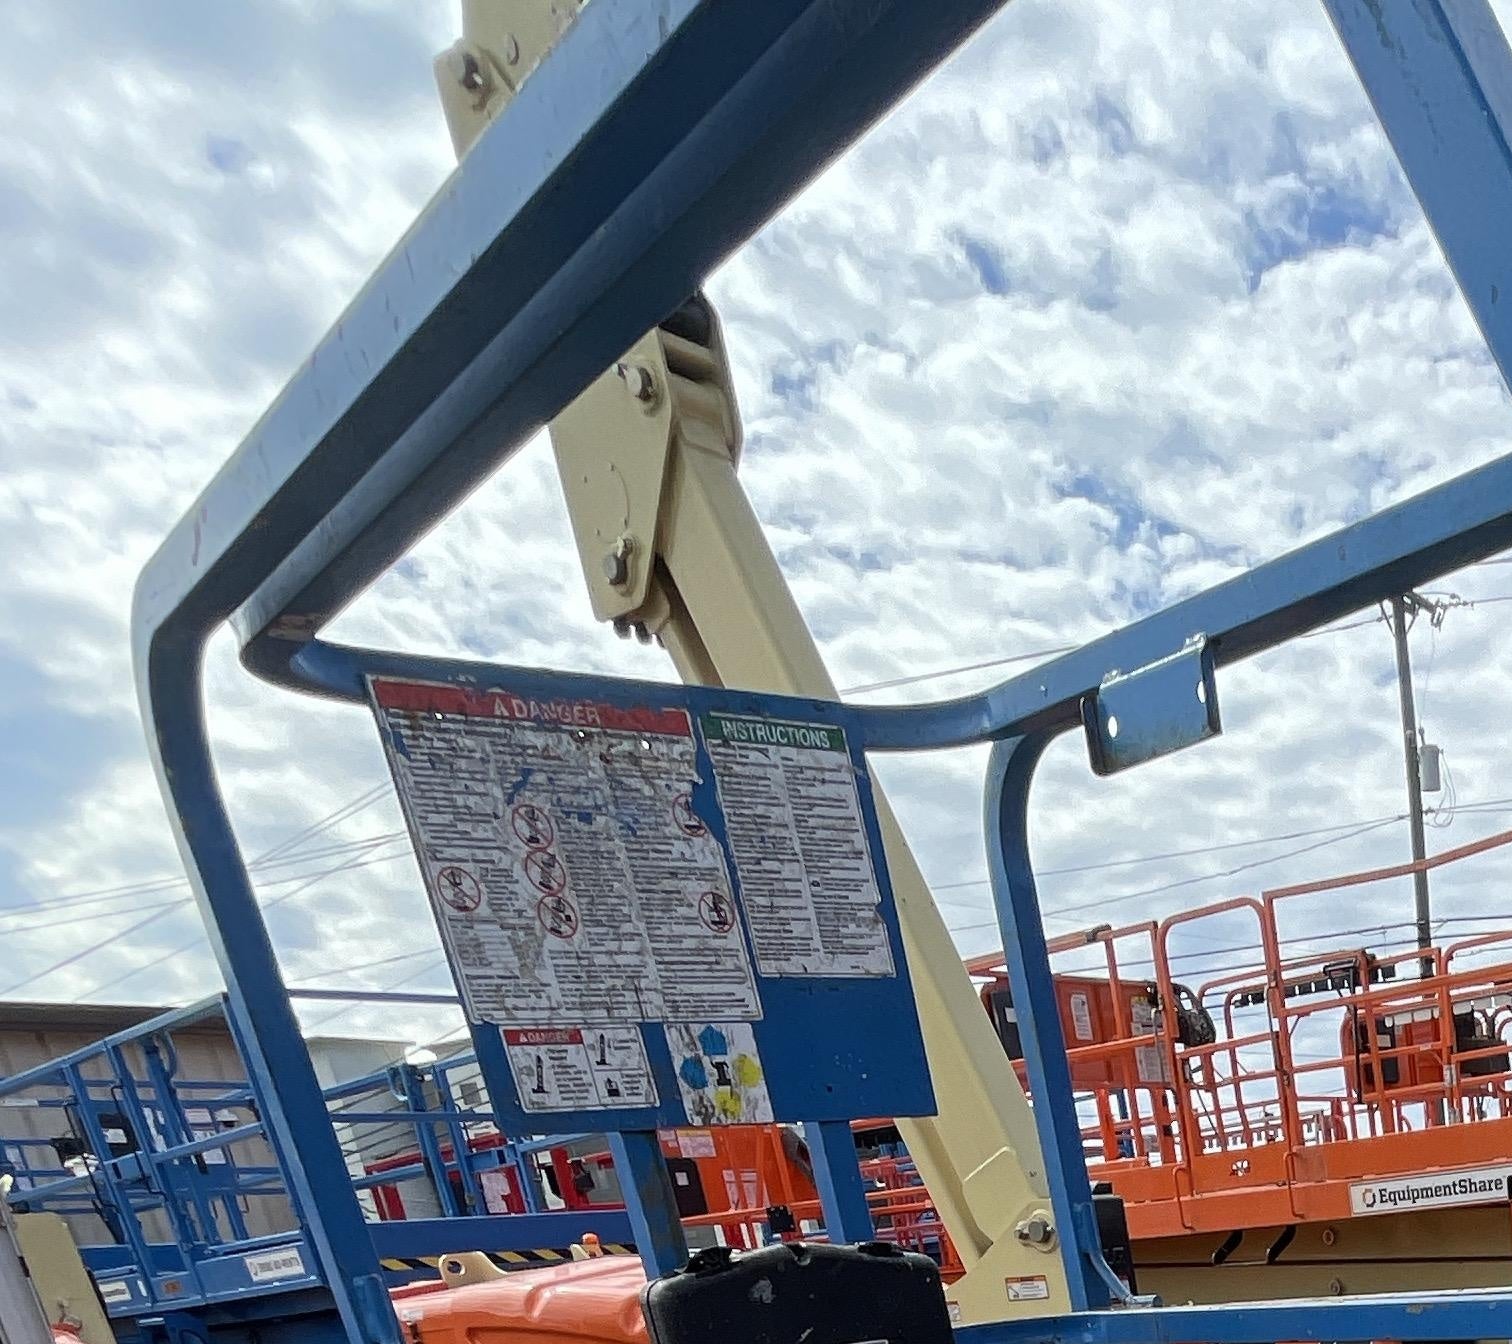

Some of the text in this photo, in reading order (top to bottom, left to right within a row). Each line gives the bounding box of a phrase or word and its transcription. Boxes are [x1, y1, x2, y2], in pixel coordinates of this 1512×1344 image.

[511, 698, 602, 725] DANGER
[721, 719, 831, 749] INSTRUCTIONS
[1378, 1176, 1504, 1206] EquipmentShare
